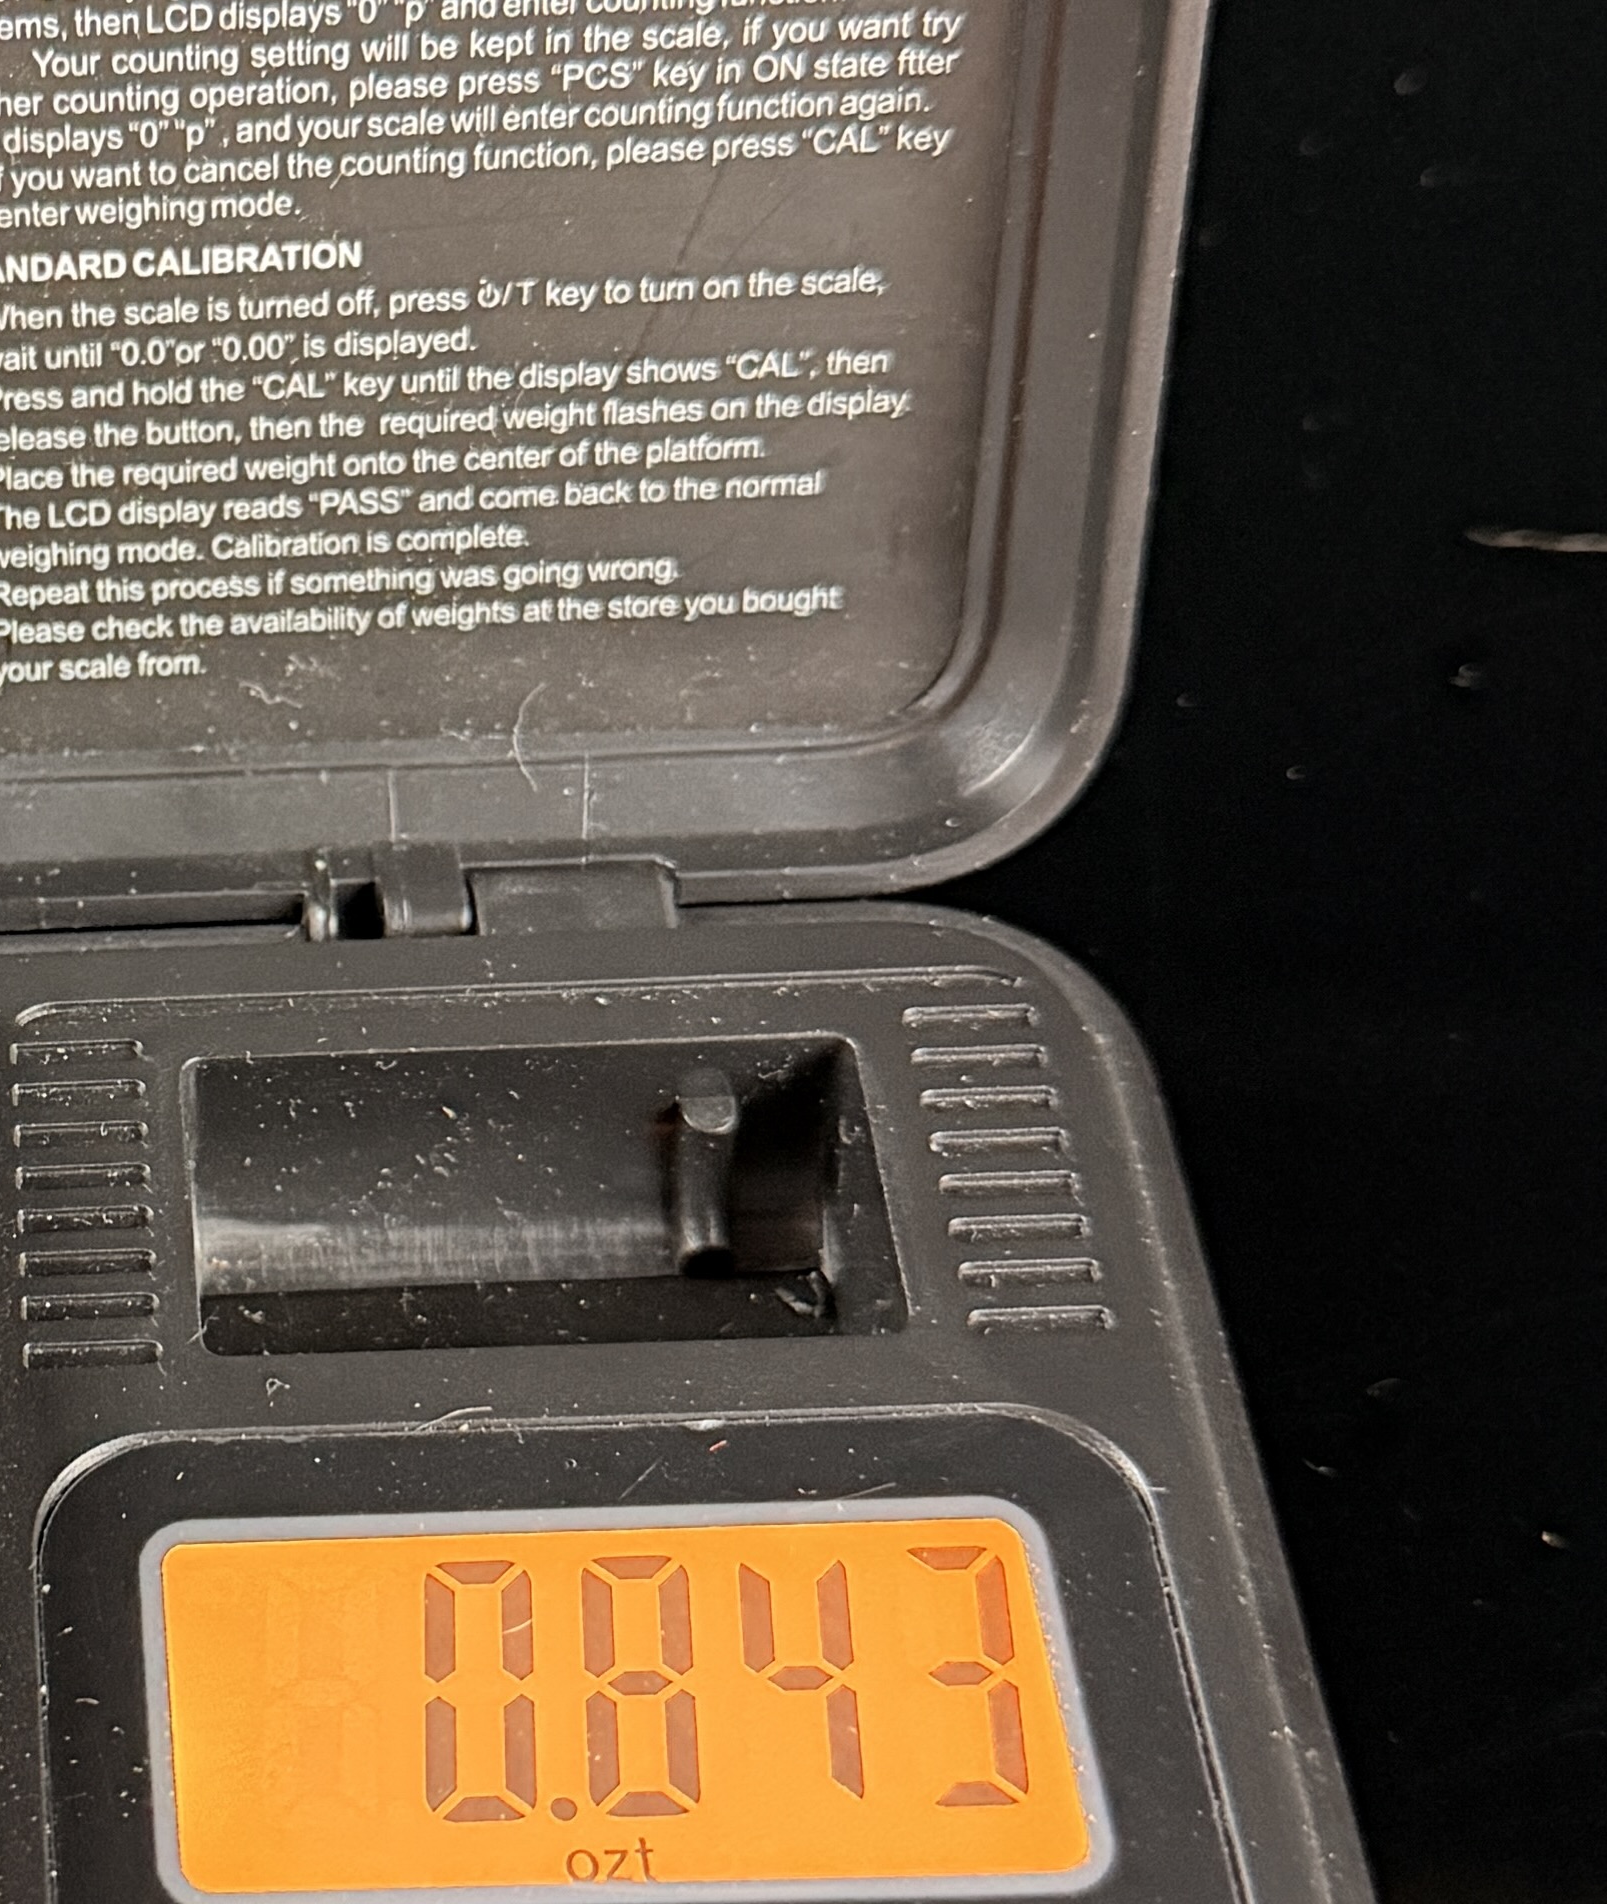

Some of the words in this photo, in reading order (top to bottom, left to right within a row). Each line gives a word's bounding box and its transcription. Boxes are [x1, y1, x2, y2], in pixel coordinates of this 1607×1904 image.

[36, 47, 100, 78] Your
[112, 41, 238, 81] counting
[251, 36, 350, 74] setting
[361, 33, 408, 63] will
[421, 31, 459, 61] be
[470, 27, 534, 64] kept
[546, 26, 572, 55] in
[582, 23, 634, 53] the
[642, 18, 731, 53] scale,
[742, 17, 762, 46] if
[771, 20, 829, 50] you
[837, 10, 914, 42] want
[922, 8, 965, 43] try
[75, 192, 206, 230] weighing
[211, 187, 301, 218] mode.
[133, 242, 362, 278] CALIBRATION
[71, 380, 124, 408] and
[133, 377, 192, 405] hold
[200, 375, 245, 403] the
[344, 368, 395, 402] key
[402, 366, 460, 394] until
[467, 364, 513, 391] the
[519, 359, 621, 395] display
[626, 355, 721, 385] shows
[825, 348, 892, 377] then
[118, 533, 203, 563] mode.
[212, 527, 360, 559] Calibration
[367, 526, 391, 553] is
[96, 575, 145, 603] this
[151, 577, 261, 607] process
[268, 570, 283, 597] if
[291, 564, 435, 601] something
[440, 568, 499, 590] was
[503, 559, 582, 593] going
[424, 1544, 1030, 1823] 0.843
[565, 1836, 659, 1885] ozt
